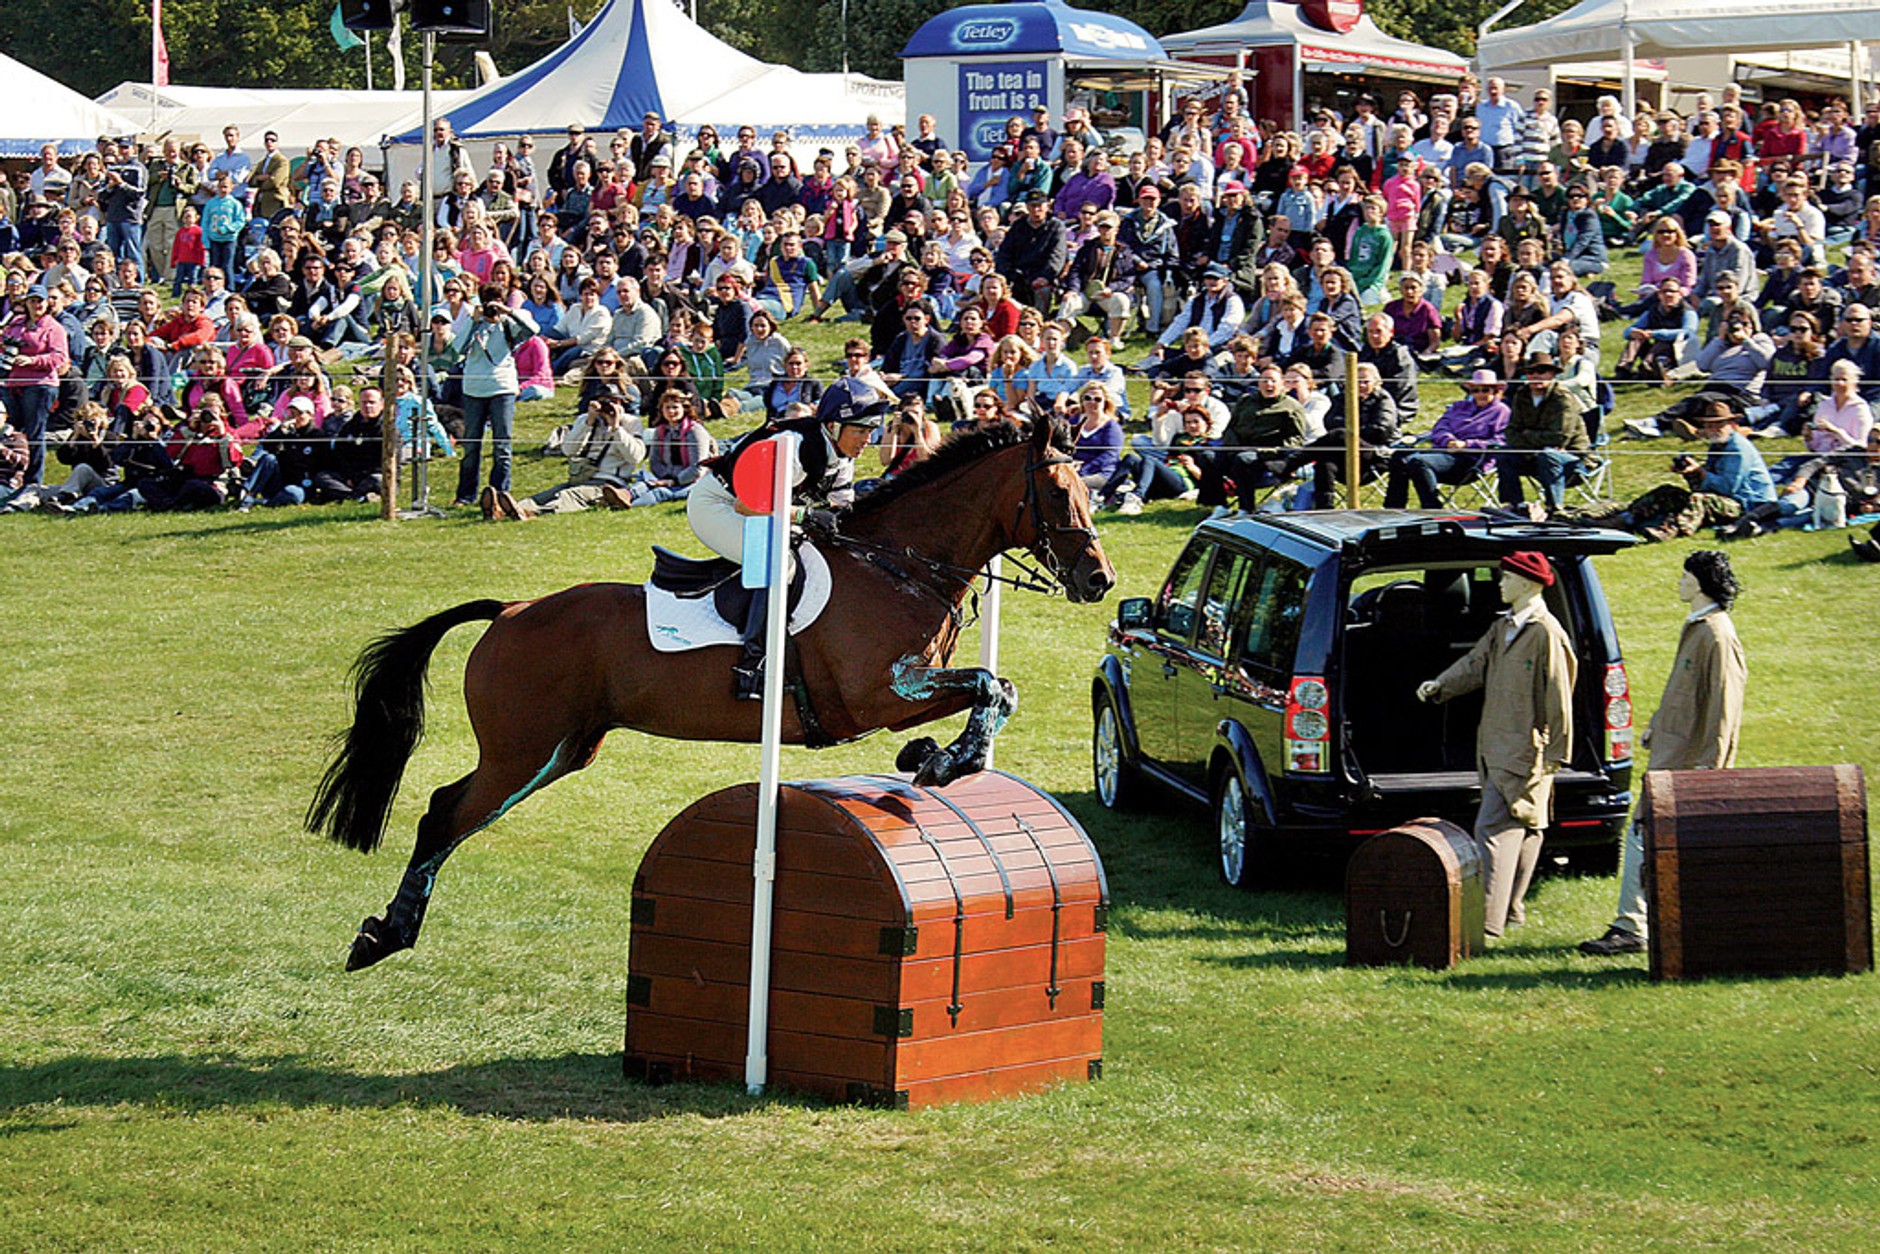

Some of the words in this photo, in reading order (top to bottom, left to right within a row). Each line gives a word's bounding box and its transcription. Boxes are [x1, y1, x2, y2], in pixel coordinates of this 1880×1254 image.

[963, 25, 1012, 40] Tetley
[965, 72, 995, 91] The
[997, 72, 1023, 90] tea
[1026, 70, 1042, 89] in
[969, 92, 1008, 111] front
[1010, 91, 1026, 110] is
[1028, 93, 1040, 110] a
